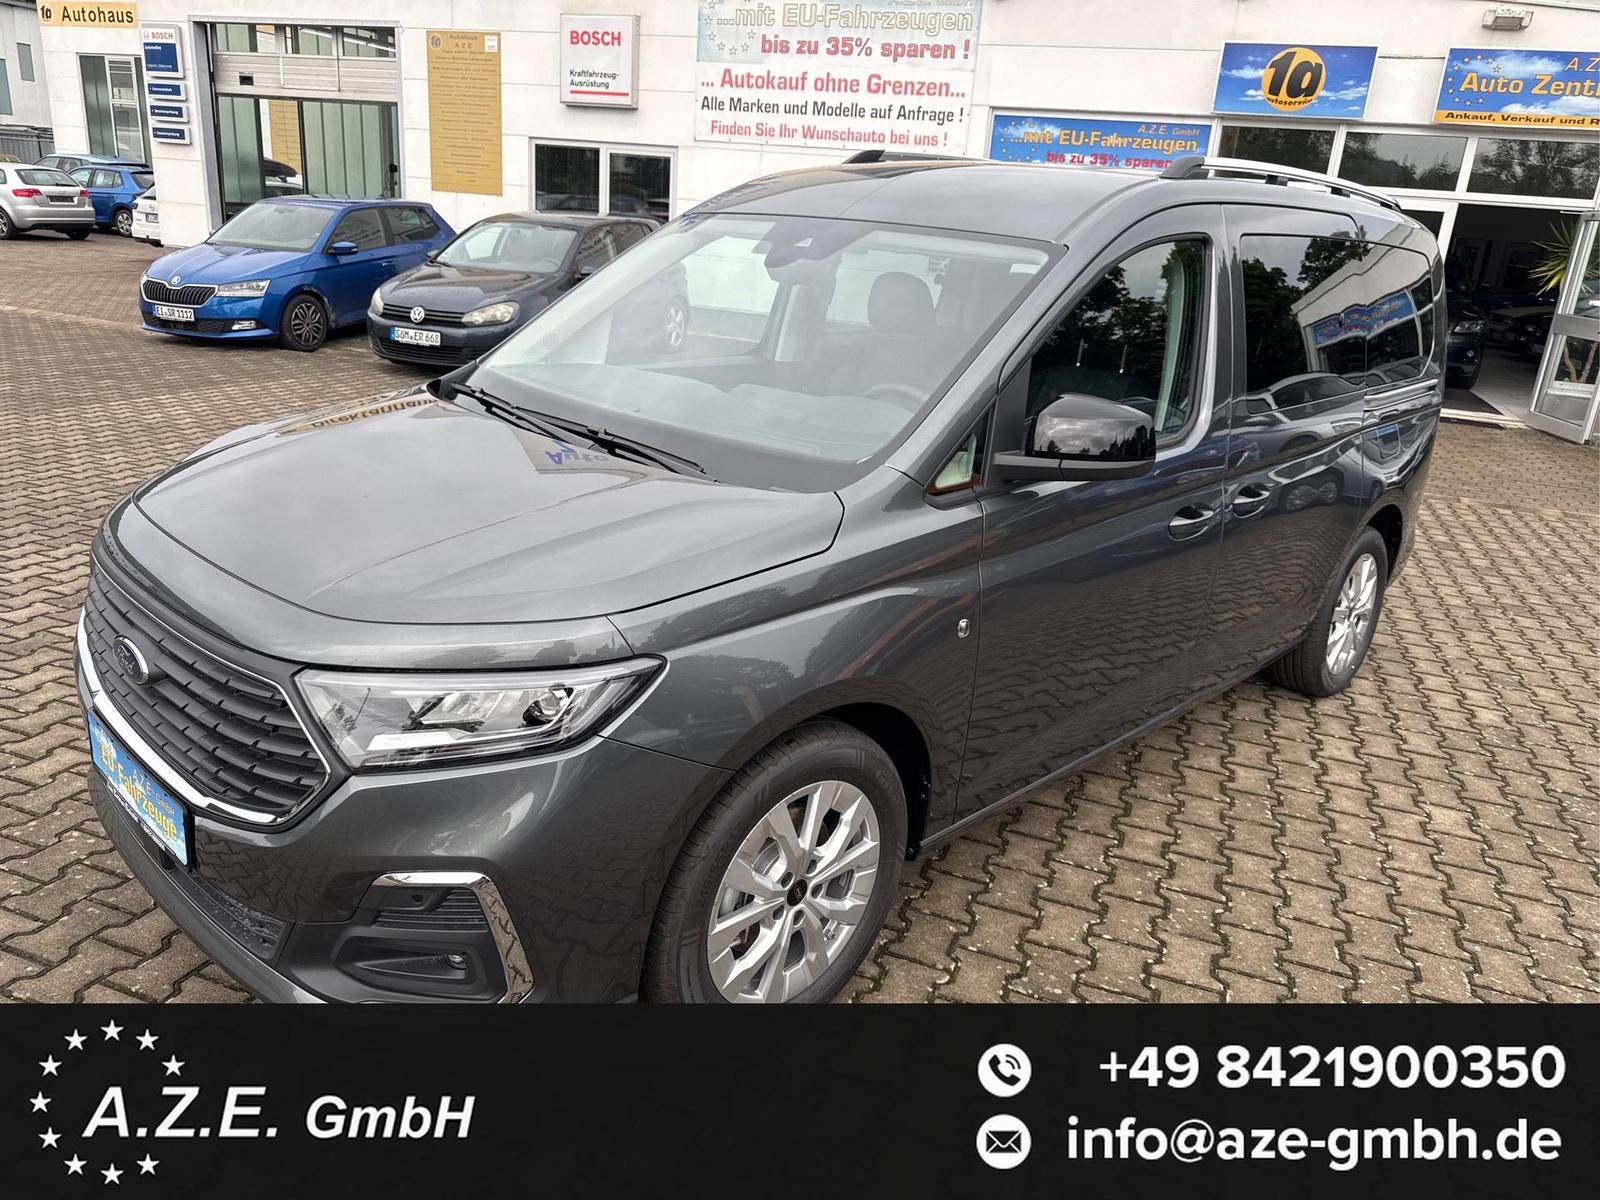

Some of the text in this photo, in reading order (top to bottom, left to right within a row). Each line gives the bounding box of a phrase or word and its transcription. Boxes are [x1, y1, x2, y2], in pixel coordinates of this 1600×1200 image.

[62, 6, 134, 23] Autohaus
[782, 3, 973, 37] EU-Fahrzeugen
[151, 32, 174, 40] BOSCH
[569, 30, 622, 46] BOSCH
[760, 34, 790, 54] bis
[796, 38, 819, 54] zu
[826, 37, 872, 56] 35%
[880, 41, 956, 62] sparen
[569, 69, 619, 81] Kraftfahrzeug-
[720, 68, 808, 91] Autokauf
[813, 72, 860, 93] ohne
[1459, 72, 1524, 93] Auto
[569, 79, 610, 89] Ausrüstung
[701, 96, 725, 111] Alle
[729, 97, 779, 114] Marken
[783, 100, 808, 115] und
[812, 101, 866, 118] Modelle
[870, 104, 893, 119] auf
[896, 104, 954, 126] Anfrage
[1445, 112, 1496, 121] Ankauf,
[1501, 114, 1556, 124] Verkauf
[1559, 117, 1586, 125] und
[710, 120, 751, 136] Finden
[755, 122, 776, 138] Sie
[779, 123, 798, 139] Ihr
[802, 124, 886, 144] Wunschauto
[889, 129, 911, 145] bei
[914, 134, 939, 146] uns
[1172, 128, 1200, 136] GmbH
[1058, 130, 1198, 155] EU-Fahrzeugen
[1046, 151, 1065, 163] bis
[1069, 155, 1084, 164] zu
[1089, 154, 1119, 168] 35%
